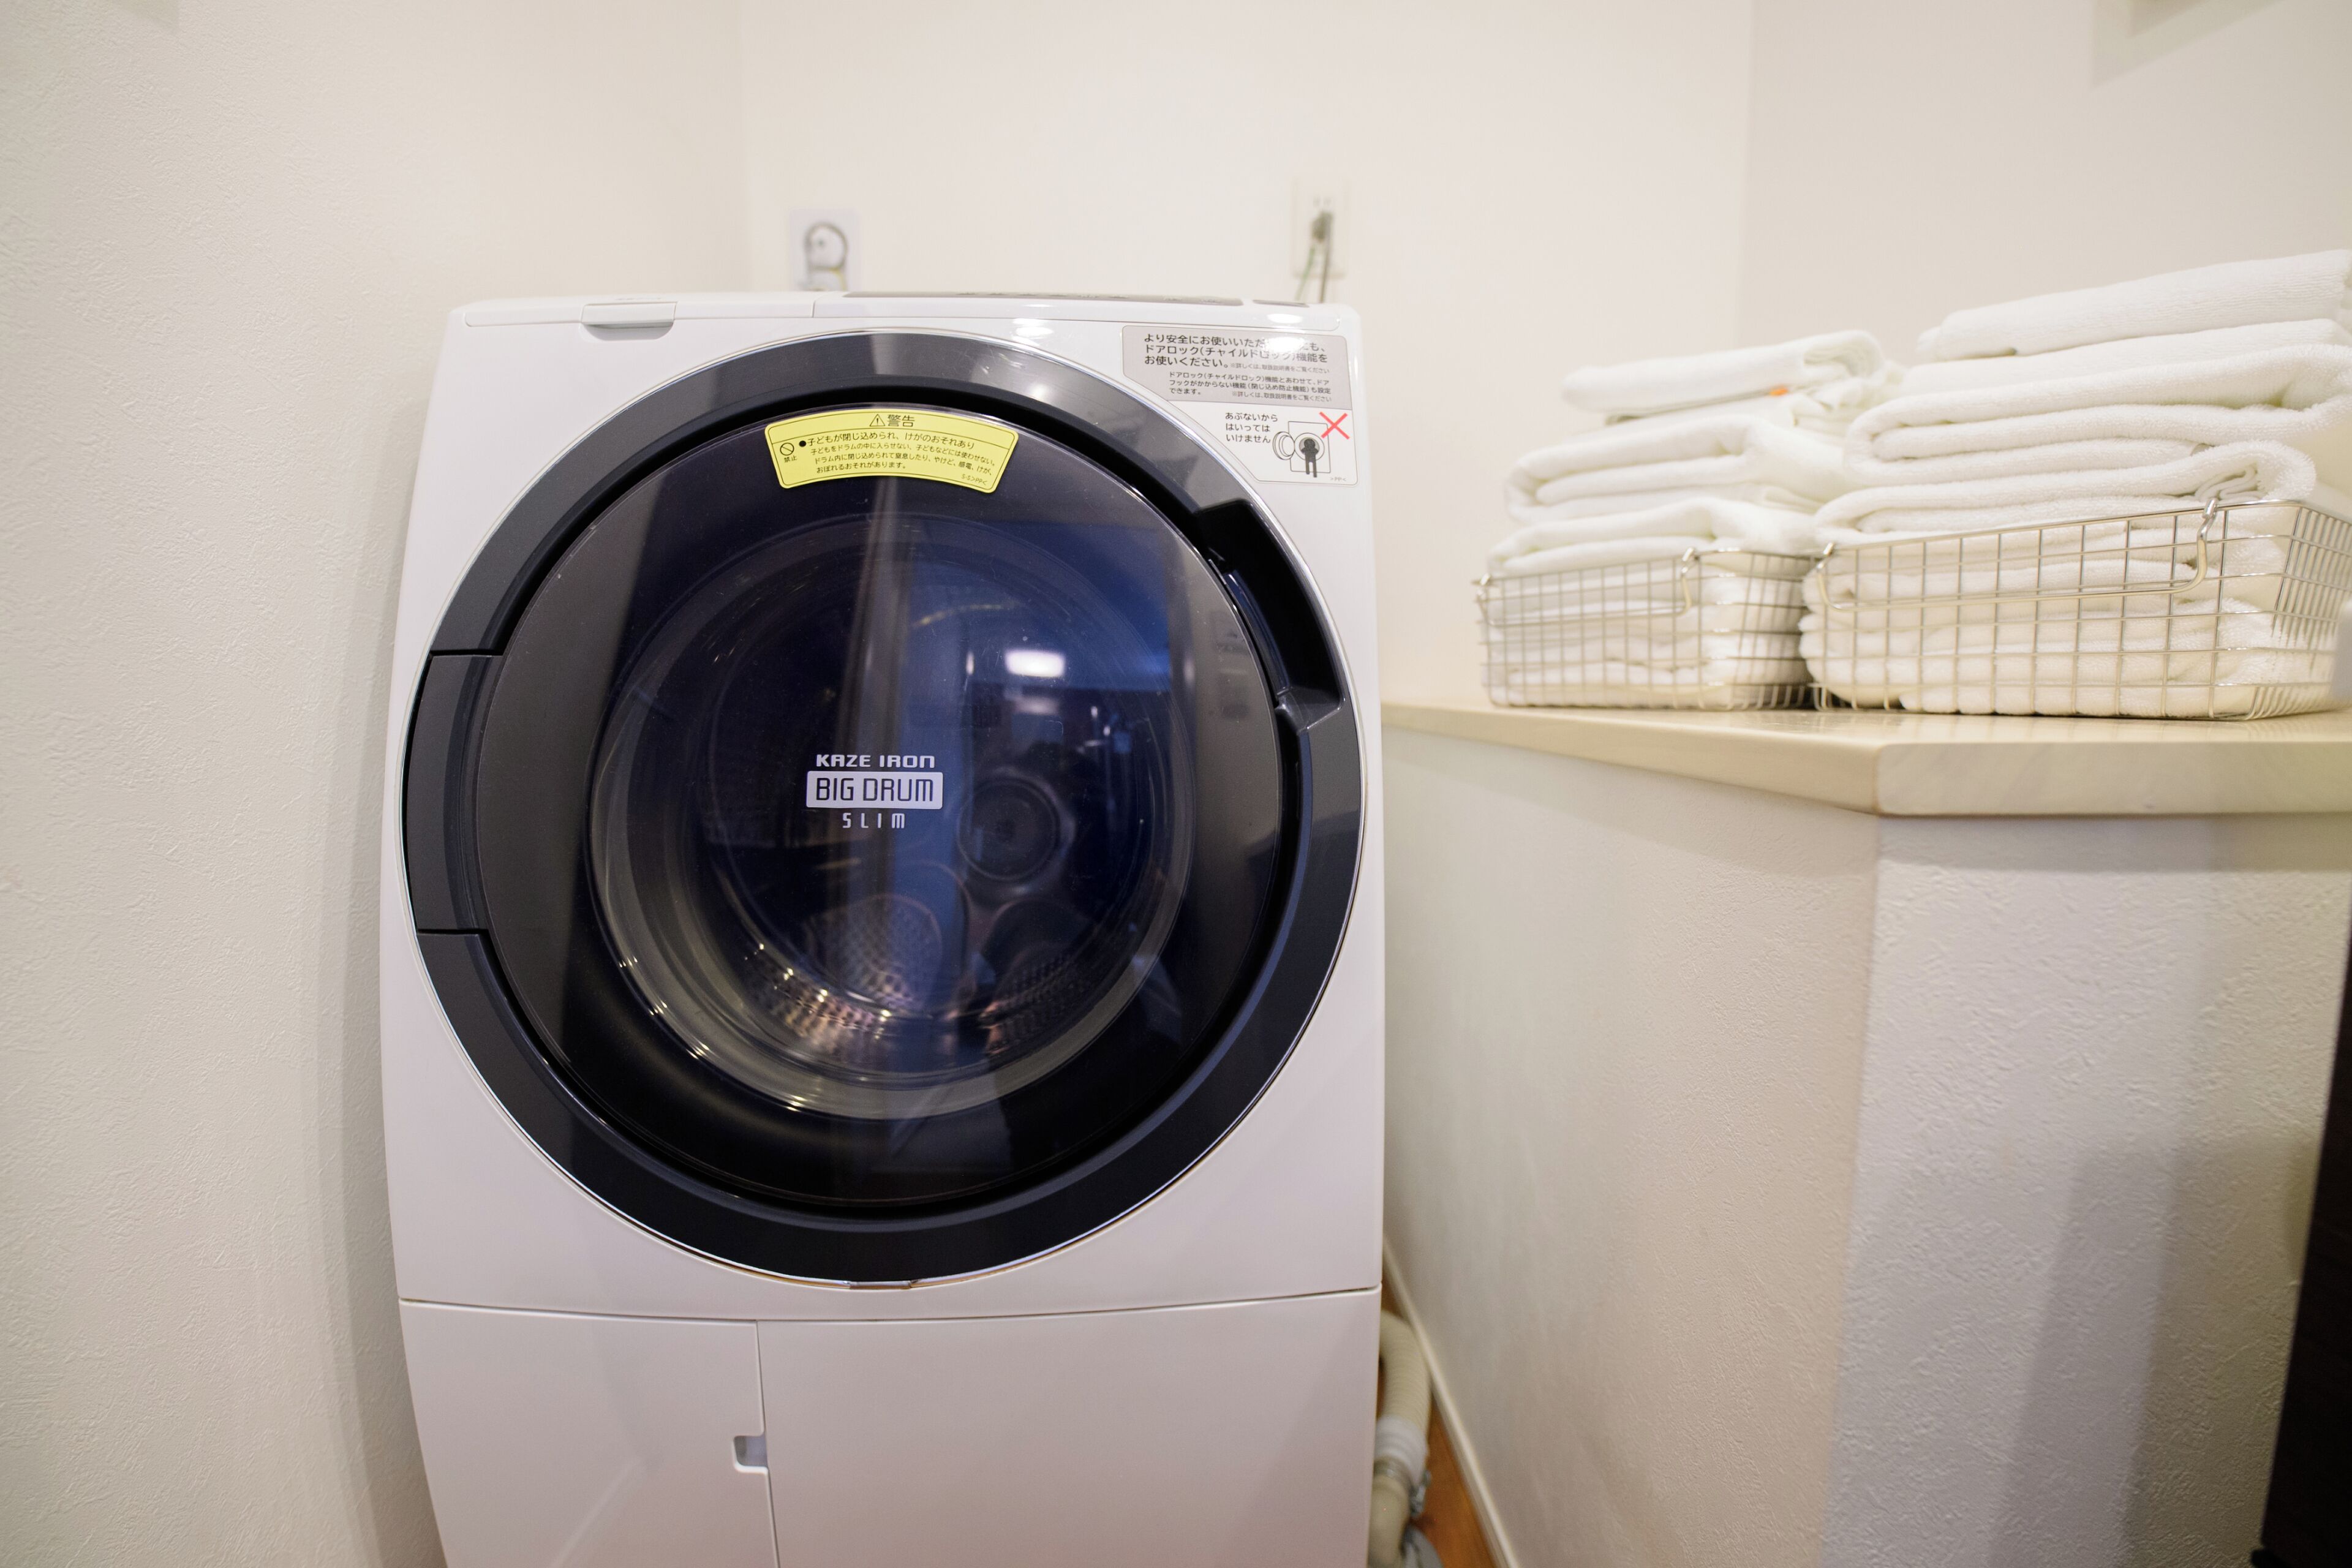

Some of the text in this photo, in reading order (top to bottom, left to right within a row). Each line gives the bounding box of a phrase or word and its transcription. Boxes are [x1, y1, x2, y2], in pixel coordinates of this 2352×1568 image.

[1145, 355, 1228, 368] お使いください。
[888, 414, 915, 428] 警告
[1225, 412, 1278, 422] あぶないから
[1226, 423, 1270, 432] はいっては
[1226, 434, 1271, 443] いけません
[816, 461, 906, 473] おぼれるおそれがあります。
[816, 754, 935, 768] KAZE IRON
[816, 777, 933, 801] BIG DRUM
[842, 812, 905, 829] SLIM
